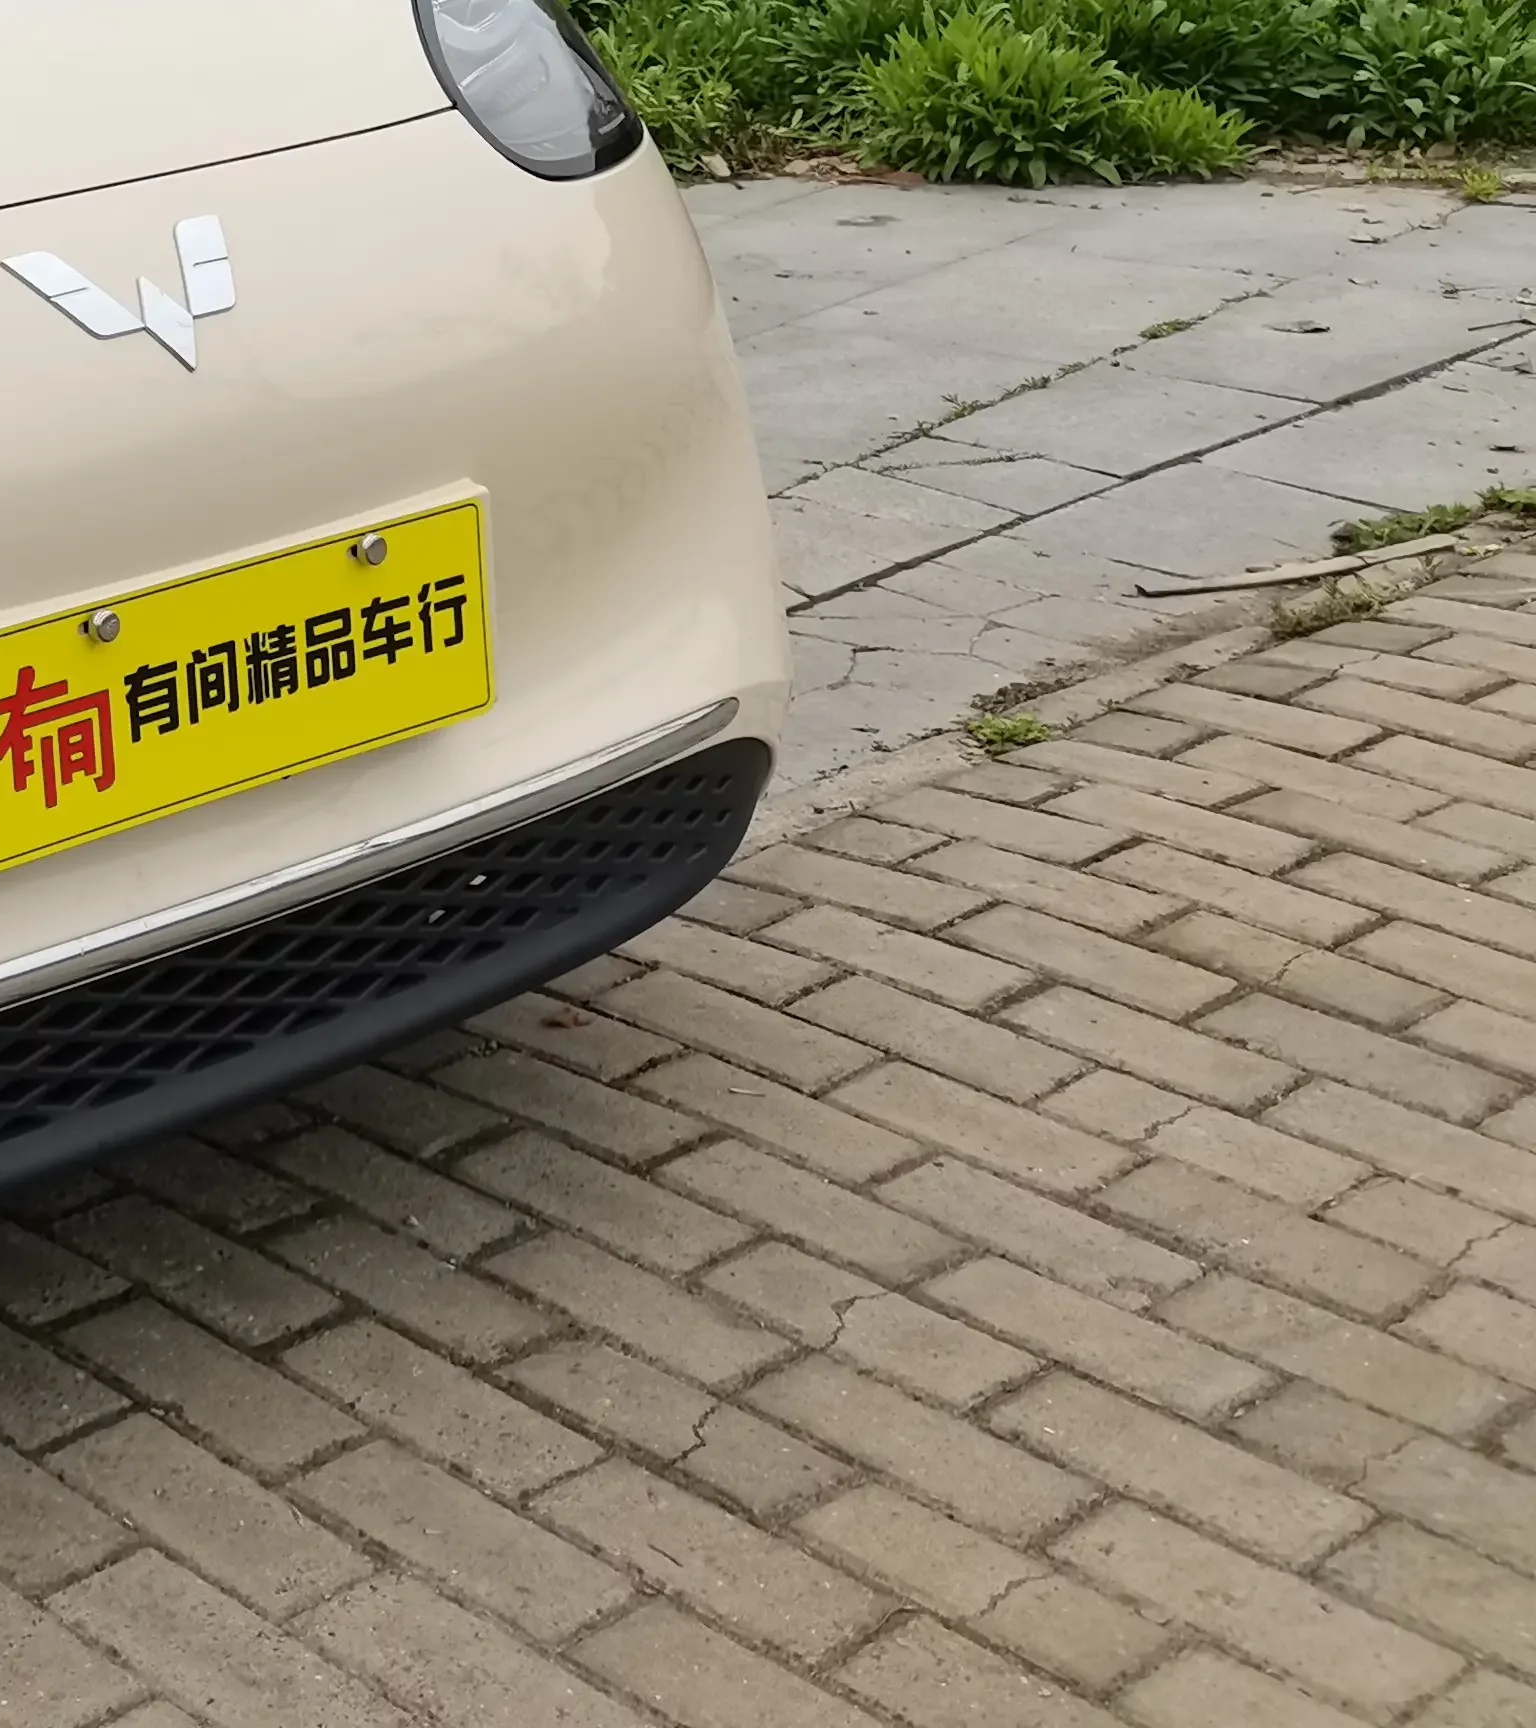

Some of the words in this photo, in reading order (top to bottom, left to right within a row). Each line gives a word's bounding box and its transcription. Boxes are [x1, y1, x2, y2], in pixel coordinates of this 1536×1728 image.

[123, 573, 467, 743] 有间精品车行
